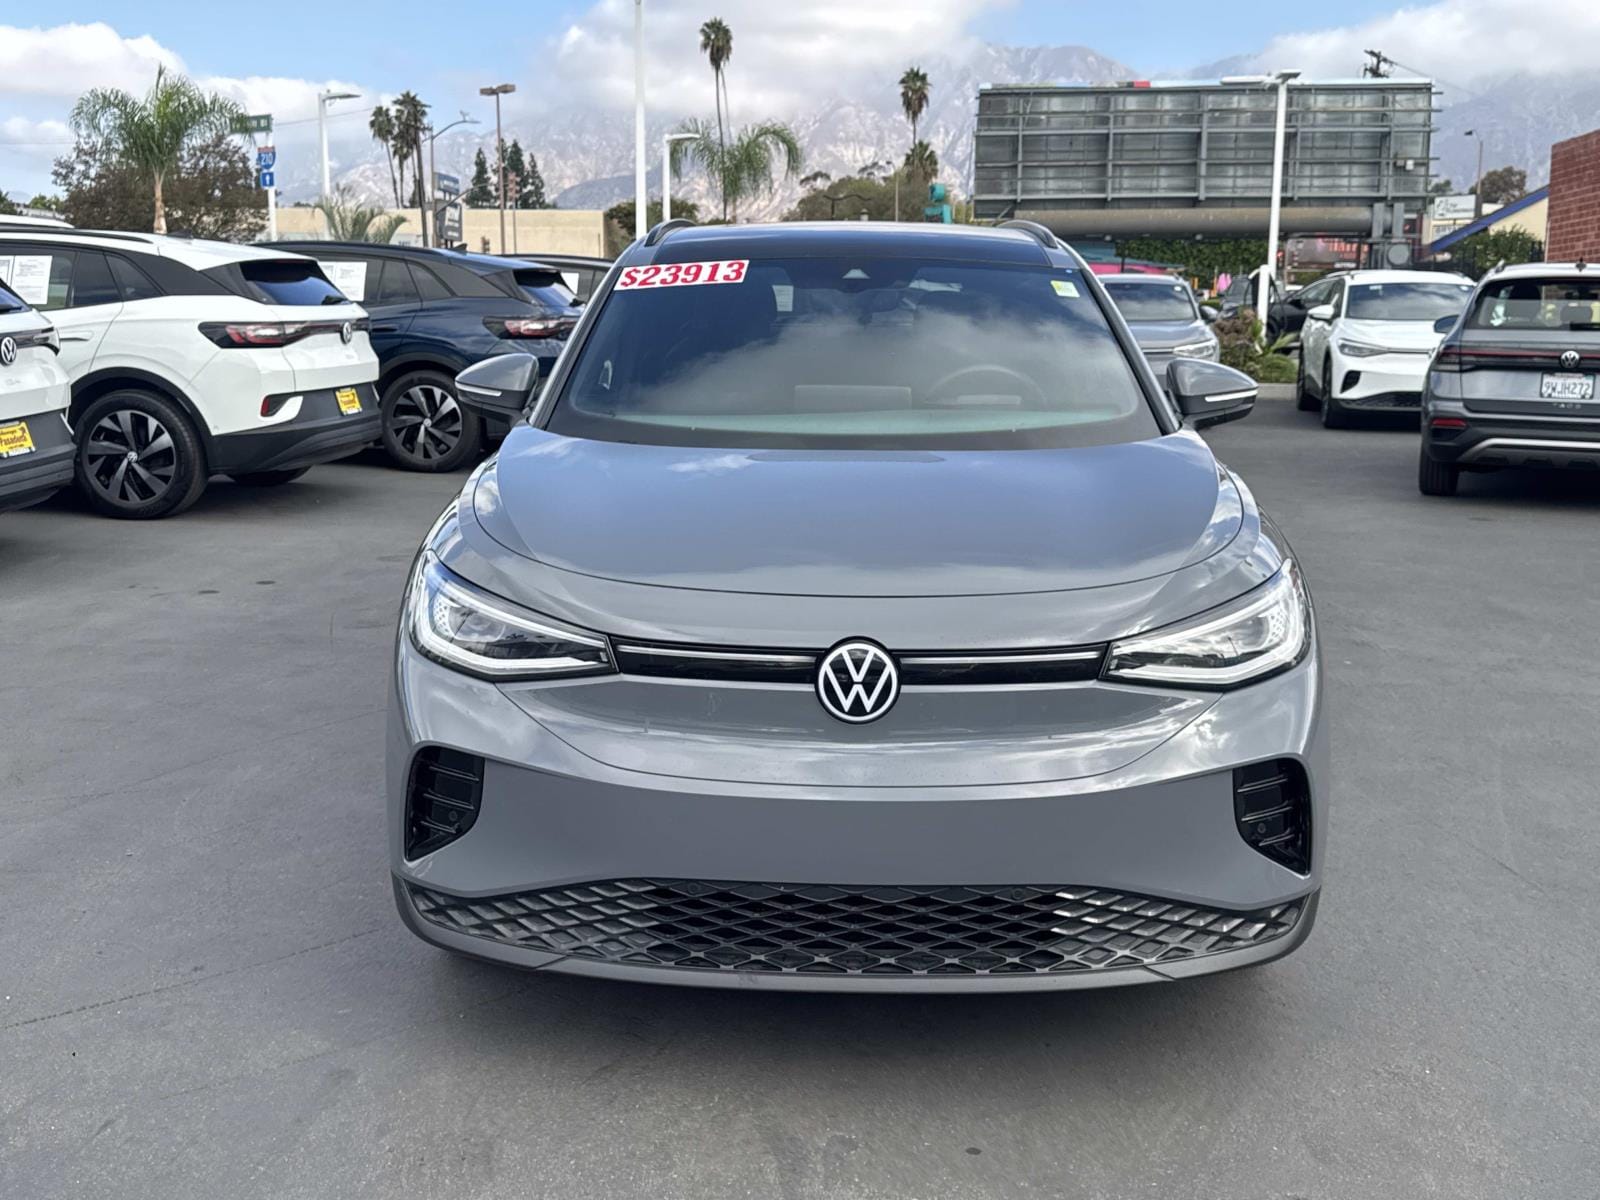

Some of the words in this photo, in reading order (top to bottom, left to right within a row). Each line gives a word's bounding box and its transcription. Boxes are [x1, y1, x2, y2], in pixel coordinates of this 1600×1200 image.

[261, 153, 274, 166] 210
[620, 261, 746, 287] $23913
[818, 642, 897, 722] VW
